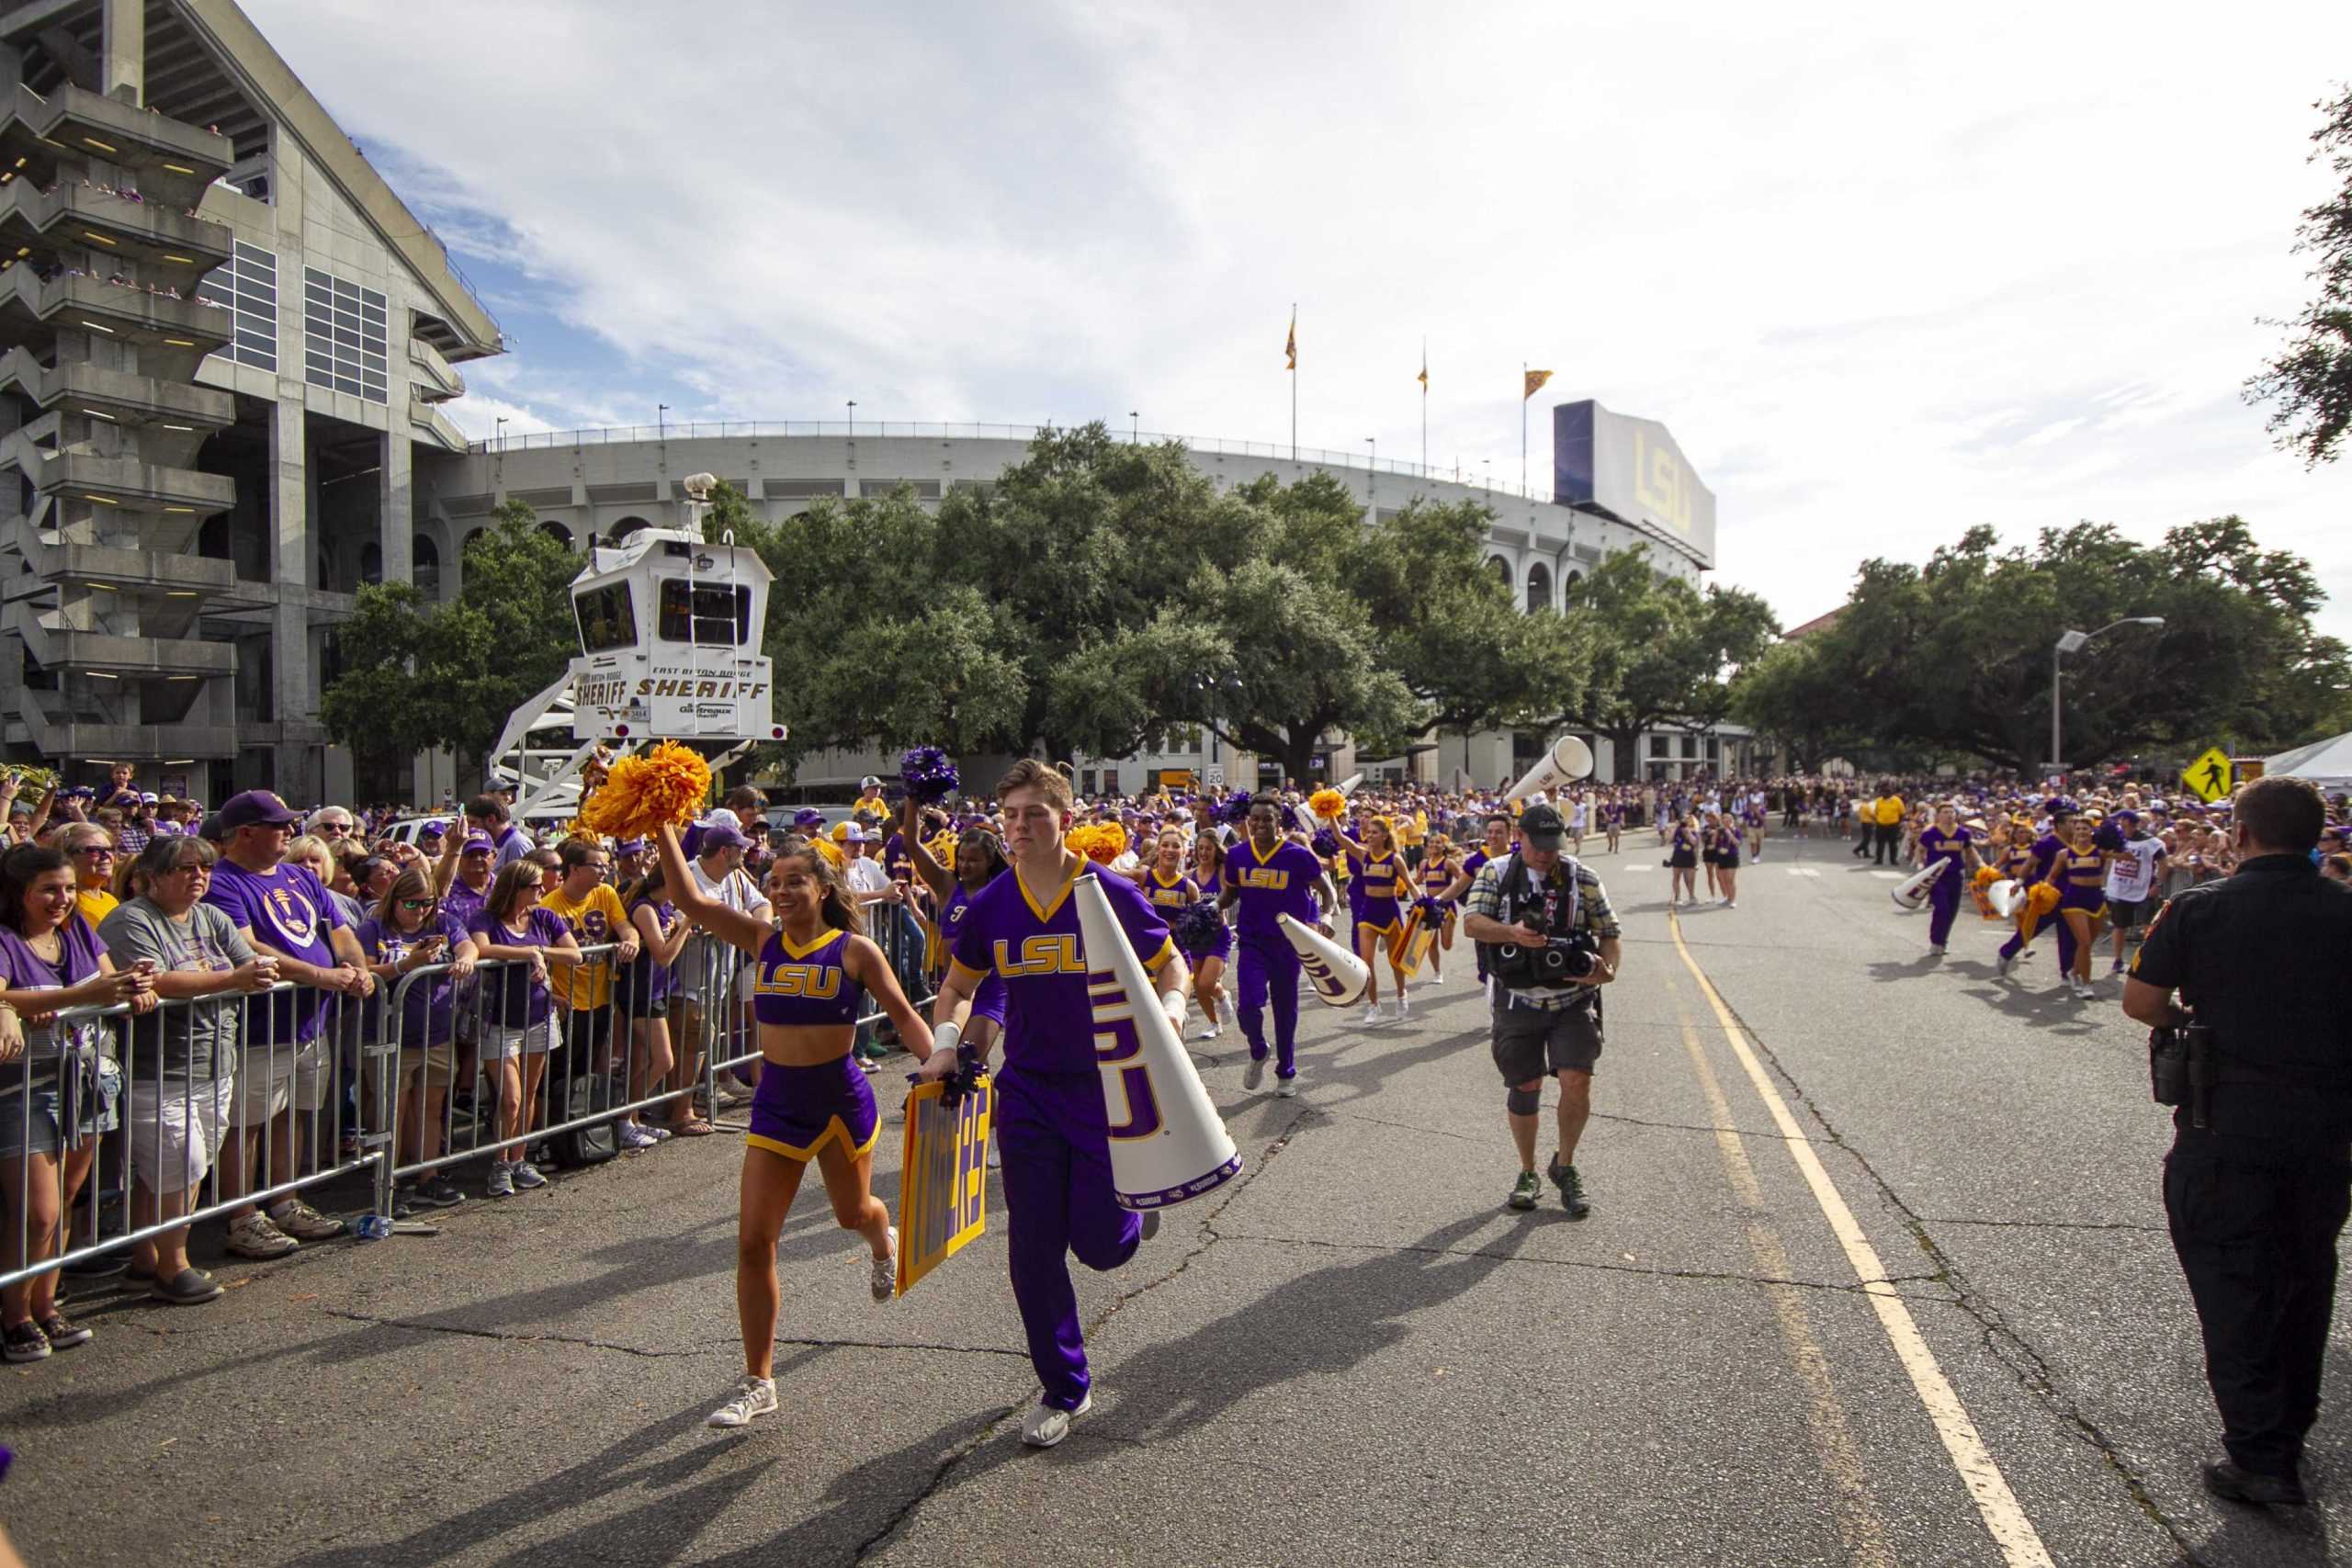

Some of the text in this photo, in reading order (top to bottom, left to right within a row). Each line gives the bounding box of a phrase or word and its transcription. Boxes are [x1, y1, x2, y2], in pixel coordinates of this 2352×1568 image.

[1634, 426, 1691, 534] LSU
[652, 666, 678, 674] EAST
[575, 680, 628, 706] SHERIFF
[636, 678, 768, 699] SHERIFF
[1209, 774, 1222, 784] 20
[1539, 772, 1555, 785] LSU
[1238, 867, 1290, 890] LSU
[1146, 886, 1188, 908] LSU
[753, 961, 842, 1000] LSU
